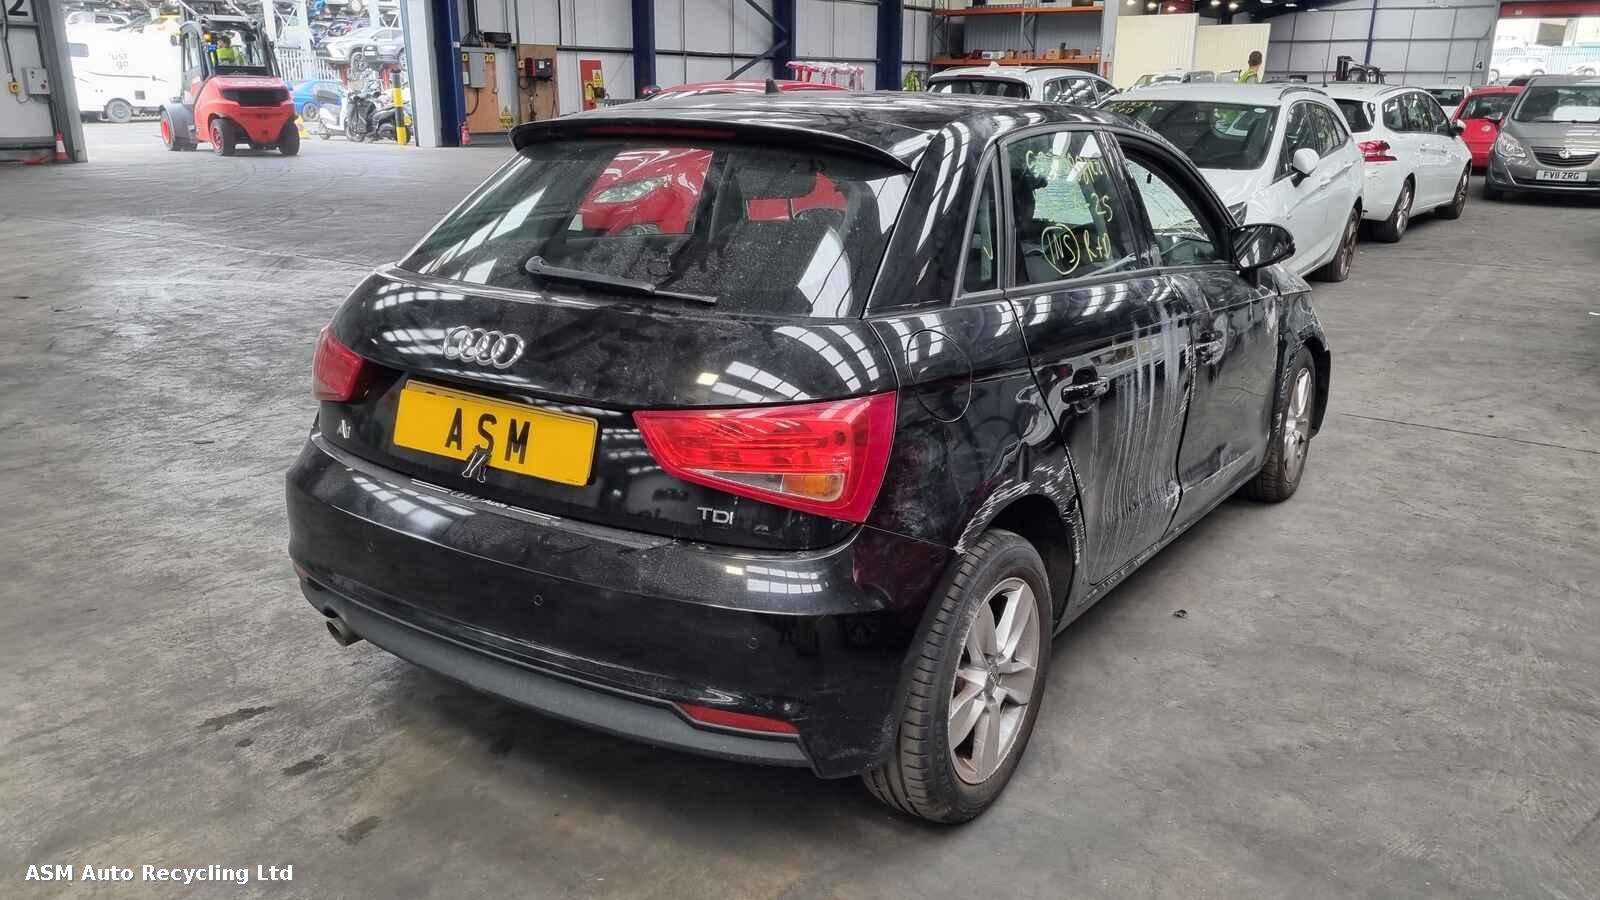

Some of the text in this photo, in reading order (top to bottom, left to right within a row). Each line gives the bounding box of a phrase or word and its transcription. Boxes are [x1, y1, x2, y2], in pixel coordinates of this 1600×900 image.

[1475, 61, 1483, 69] 4
[444, 407, 531, 465] ASM
[696, 506, 734, 525] TDI
